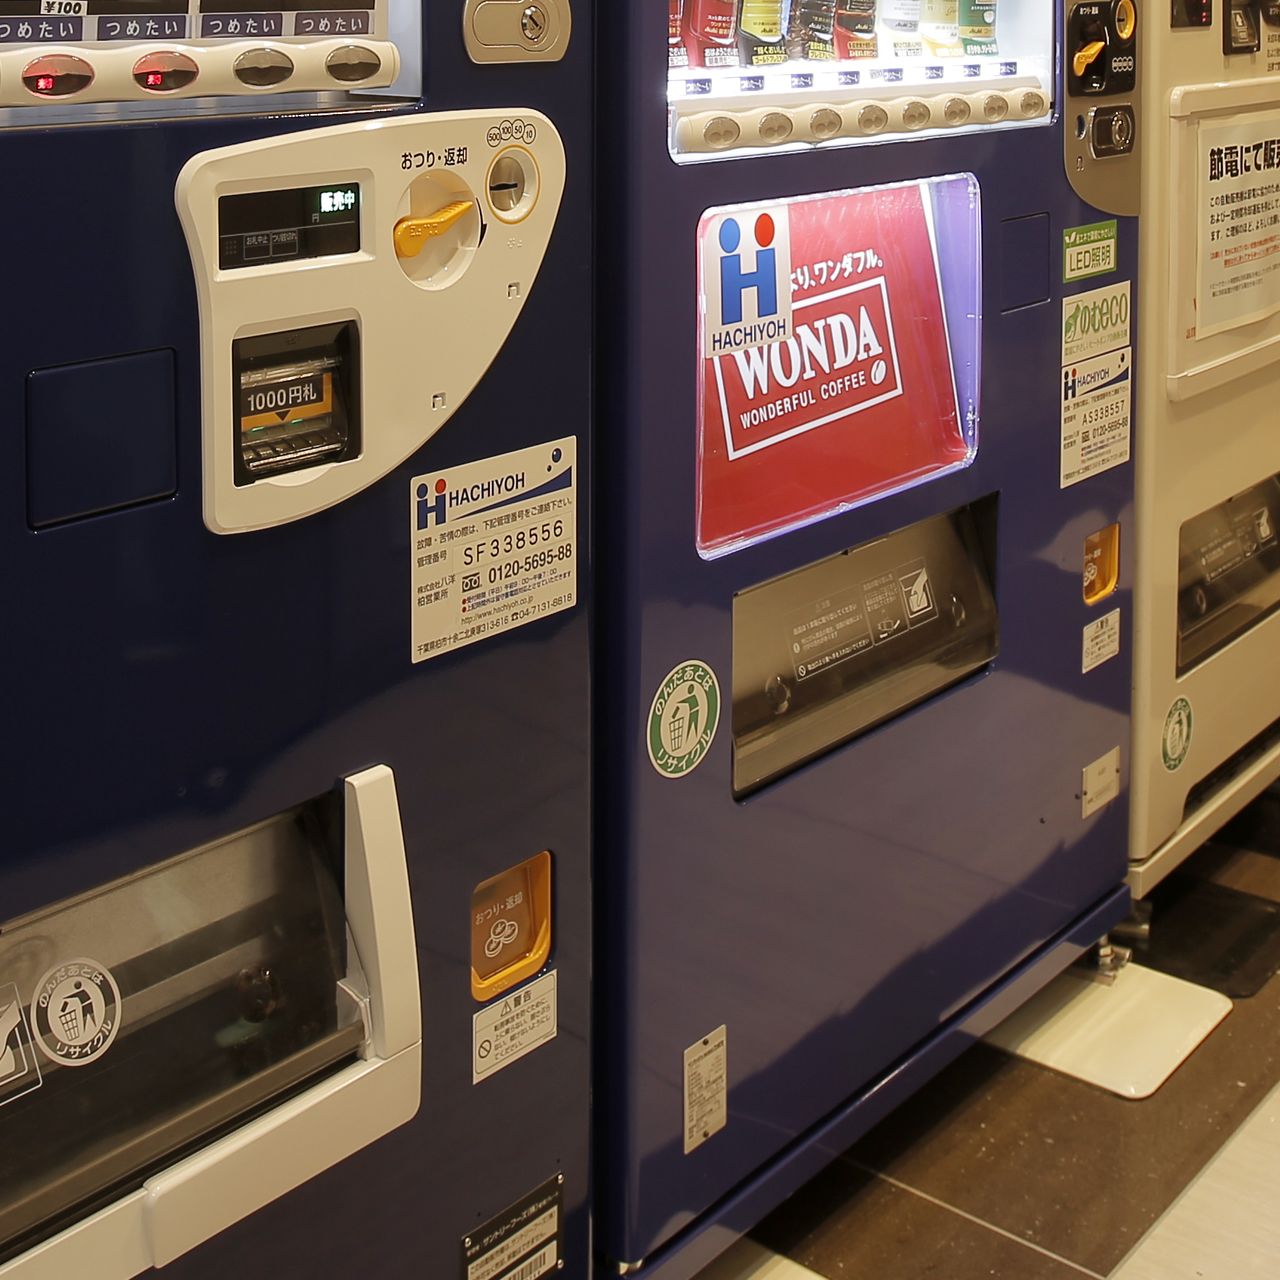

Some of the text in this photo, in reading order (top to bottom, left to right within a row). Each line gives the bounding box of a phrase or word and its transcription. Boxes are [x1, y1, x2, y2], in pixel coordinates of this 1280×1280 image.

[45, 0, 82, 16] ¥100
[106, 18, 178, 37] つめたい
[209, 17, 276, 36] つめたい
[488, 124, 533, 142] 500 100 50 10
[400, 147, 468, 169] おつり・返却
[320, 192, 355, 214] 販売中
[1070, 245, 1110, 272] LED照明
[712, 319, 786, 351] HACHIYOH
[731, 304, 882, 401] WONDA
[1077, 368, 1109, 388] HACHIYOH
[247, 383, 317, 412] 1000円札
[740, 370, 866, 429] WONDERFUL COFFEE
[1082, 400, 1125, 426] AS338557
[449, 472, 525, 508] HACHIYOH
[417, 519, 564, 568] 管理番号 SF338556
[488, 543, 572, 584] 0120-5695-88
[417, 590, 449, 607] 柏営業所
[654, 666, 713, 715] のんだあとは
[657, 727, 712, 773] リサイクル
[38, 964, 104, 1010] のんだあとは
[514, 991, 532, 1008] 警告
[56, 1019, 114, 1059] リサイクル
